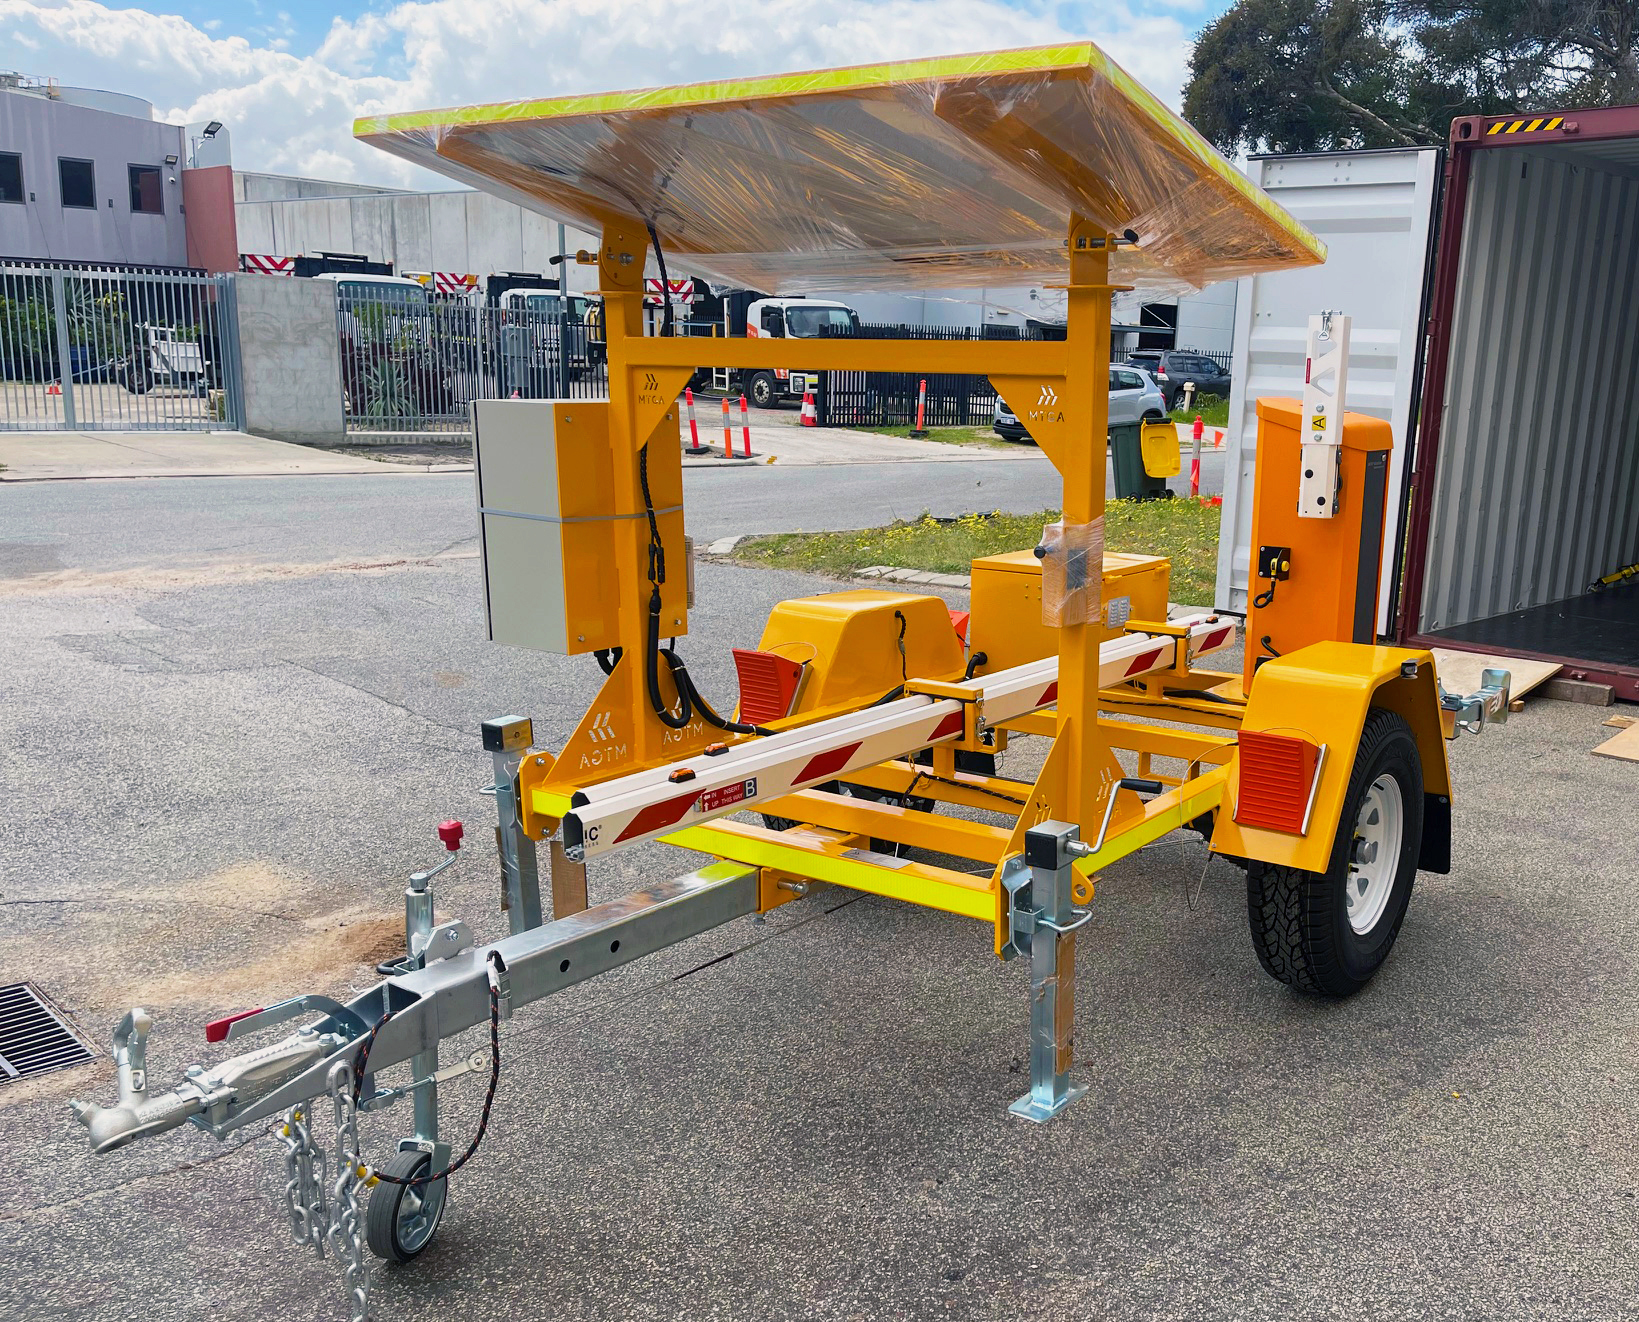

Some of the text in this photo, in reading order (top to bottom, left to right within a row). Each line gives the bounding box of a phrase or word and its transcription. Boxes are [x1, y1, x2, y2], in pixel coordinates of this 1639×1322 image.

[1312, 417, 1325, 429] A
[724, 785, 740, 795] INSERT
[745, 780, 755, 798] B
